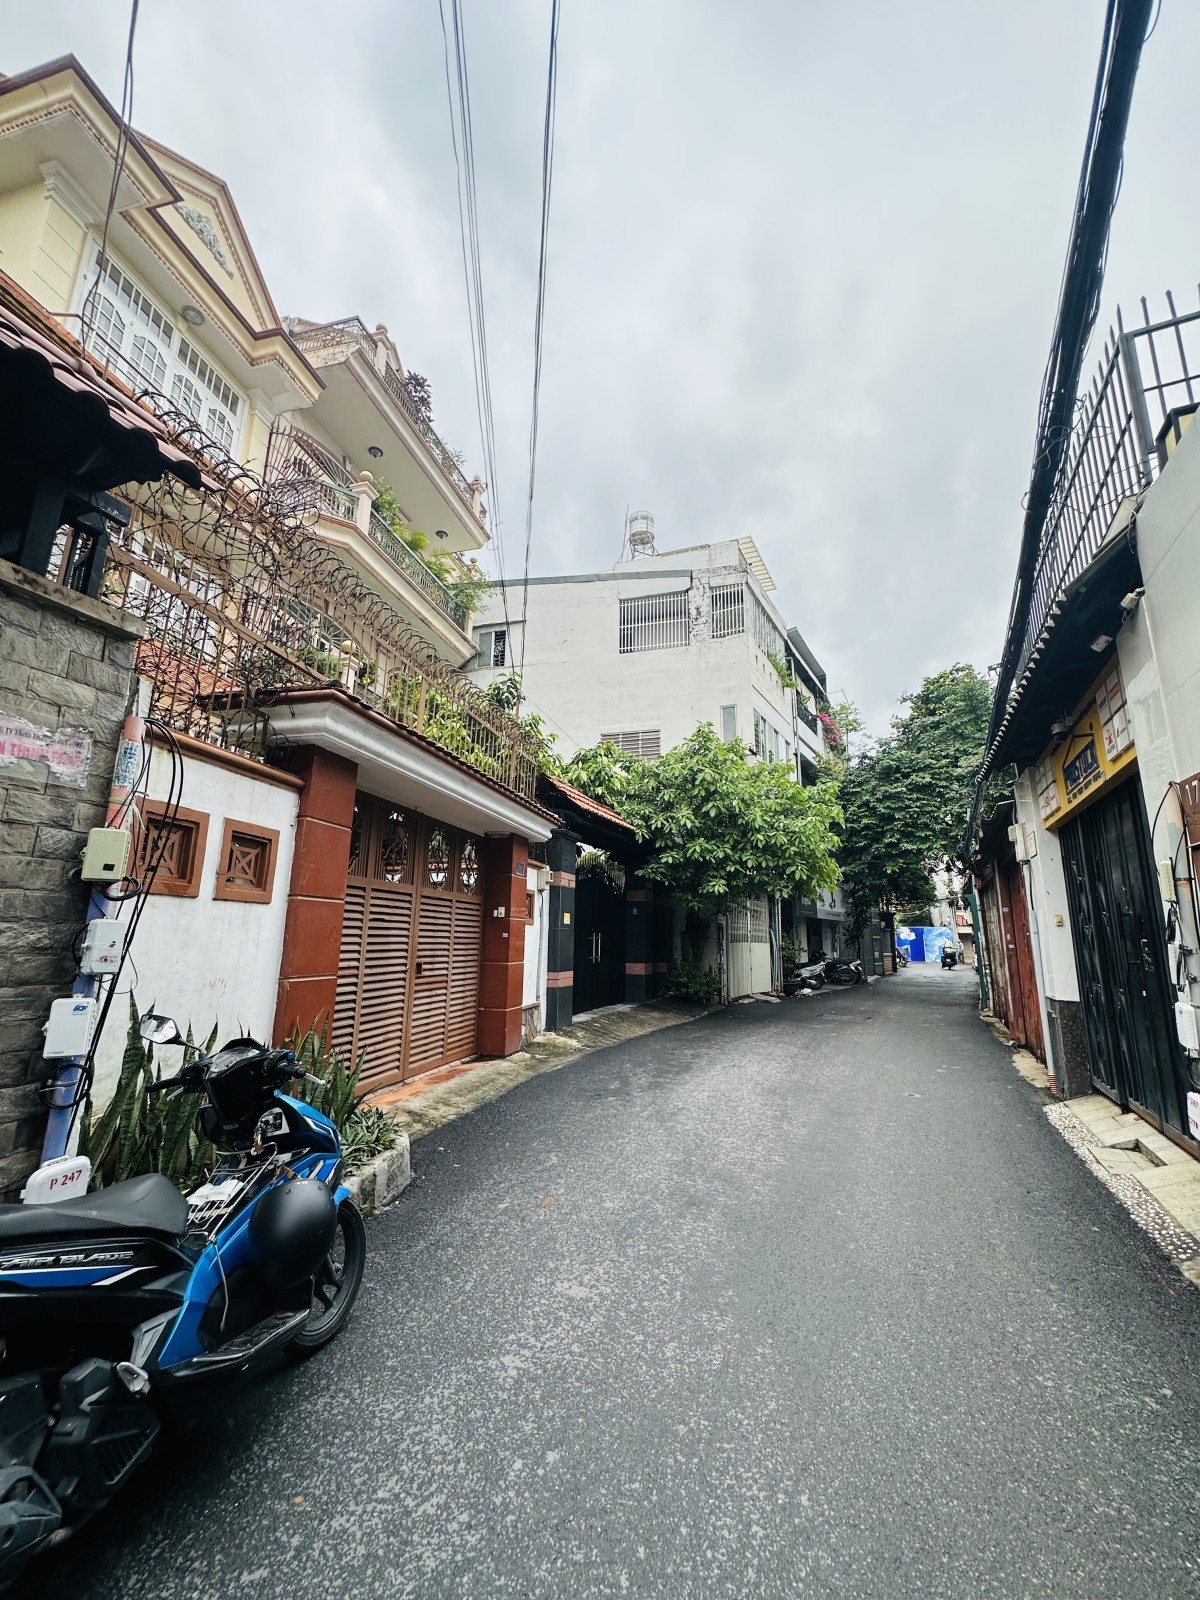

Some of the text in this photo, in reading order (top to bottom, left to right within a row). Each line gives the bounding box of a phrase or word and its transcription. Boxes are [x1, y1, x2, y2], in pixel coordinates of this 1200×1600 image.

[50, 1169, 82, 1190] P 247
[60, 1251, 134, 1264] BLADE
